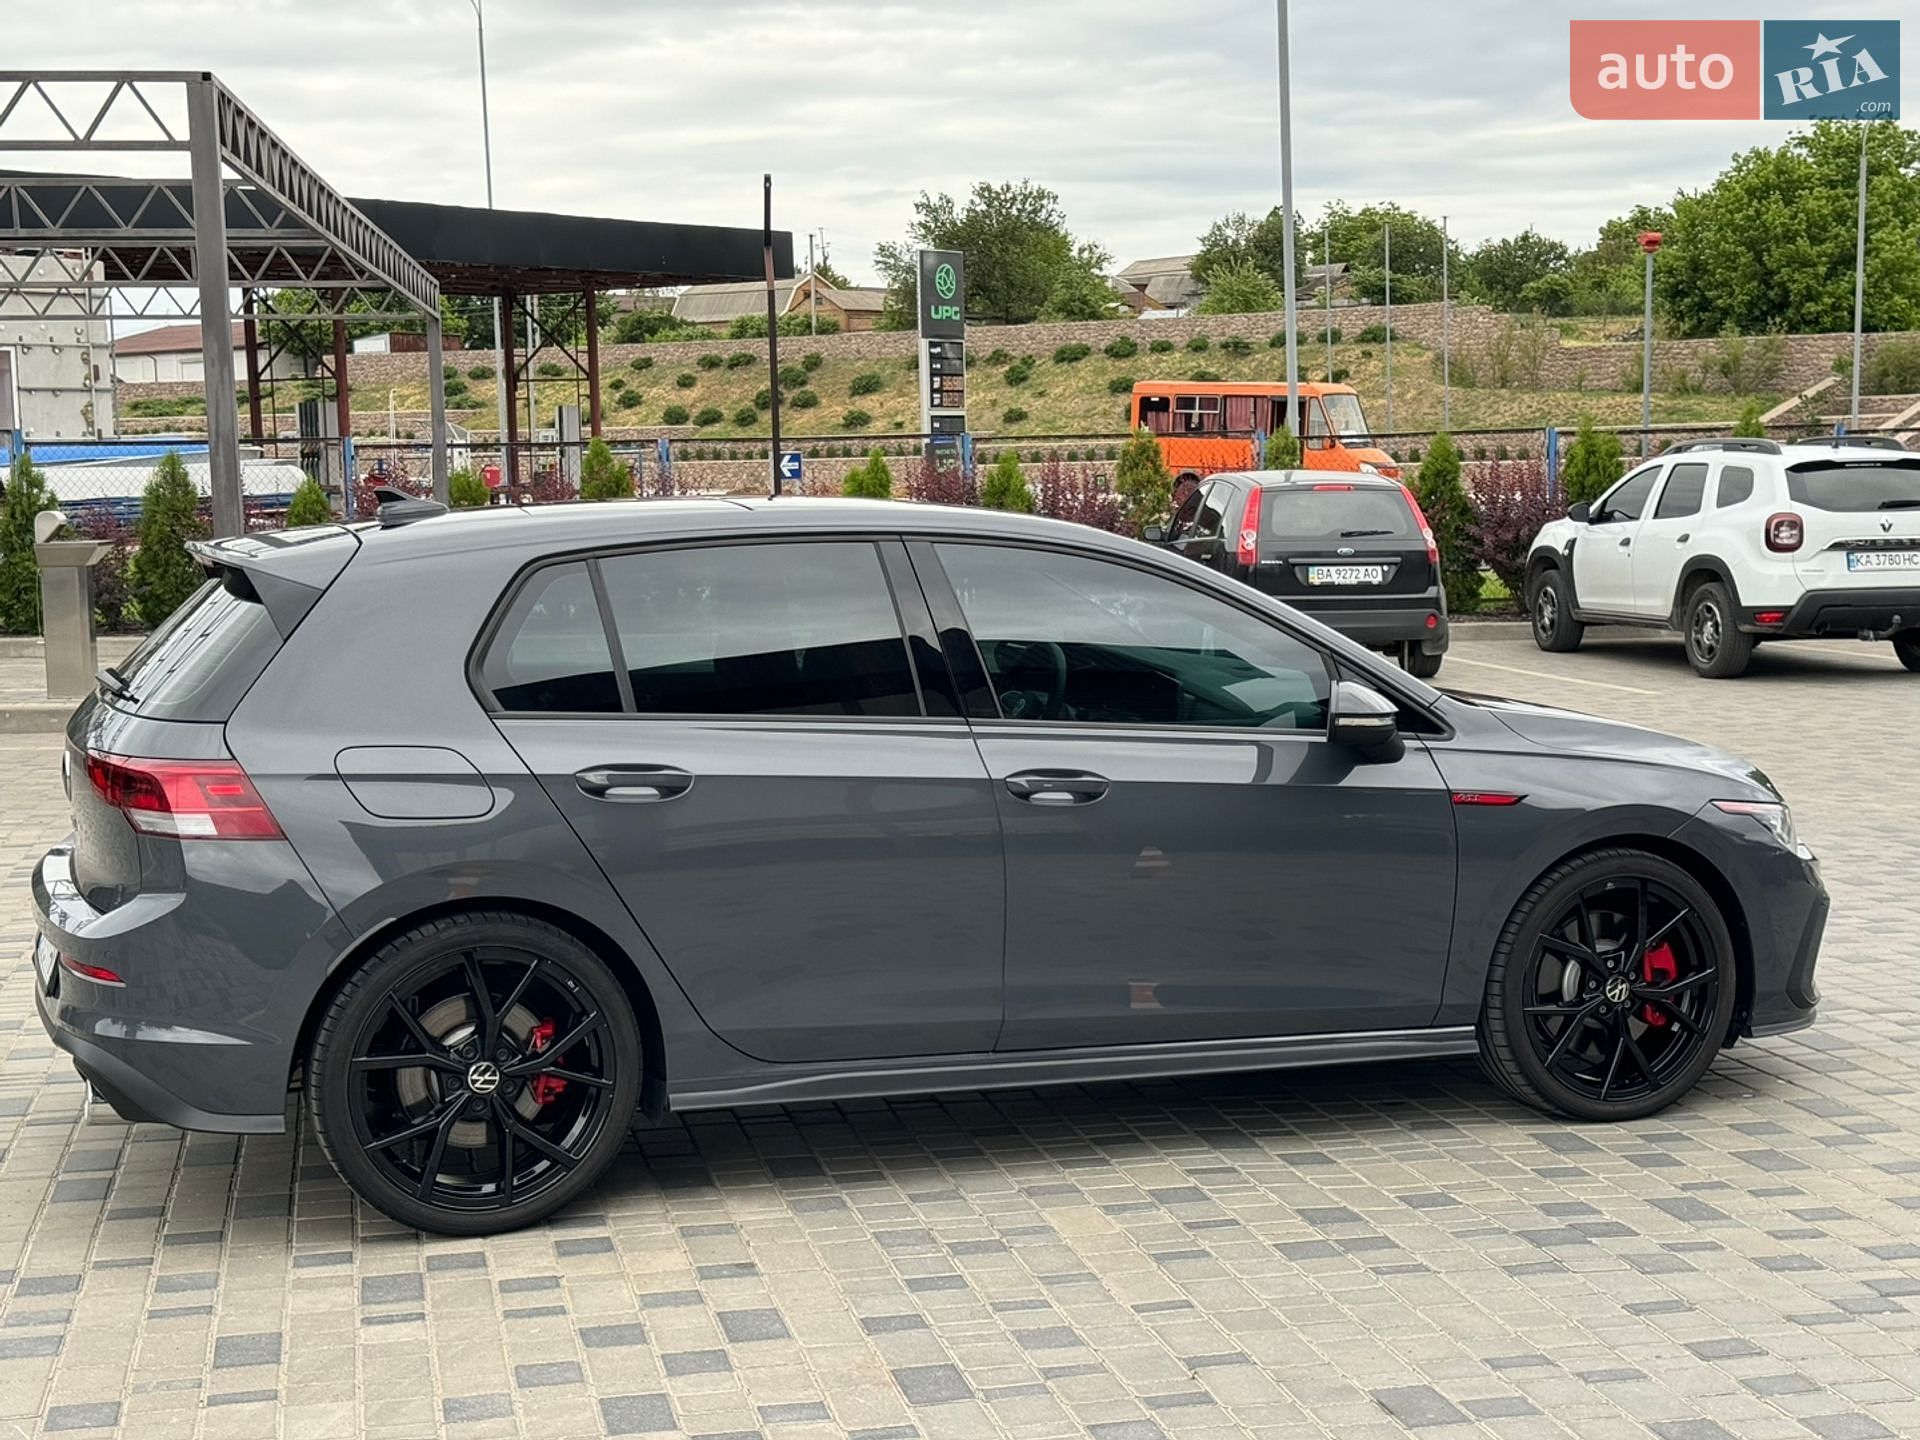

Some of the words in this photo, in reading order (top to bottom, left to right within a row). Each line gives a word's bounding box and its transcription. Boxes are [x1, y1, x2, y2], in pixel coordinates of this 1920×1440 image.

[930, 305, 961, 320] UPG
[1855, 554, 1873, 566] KA
[1902, 553, 1920, 566] HC
[1316, 568, 1334, 580] BA
[1335, 567, 1360, 580] 9272
[1363, 567, 1379, 580] AO
